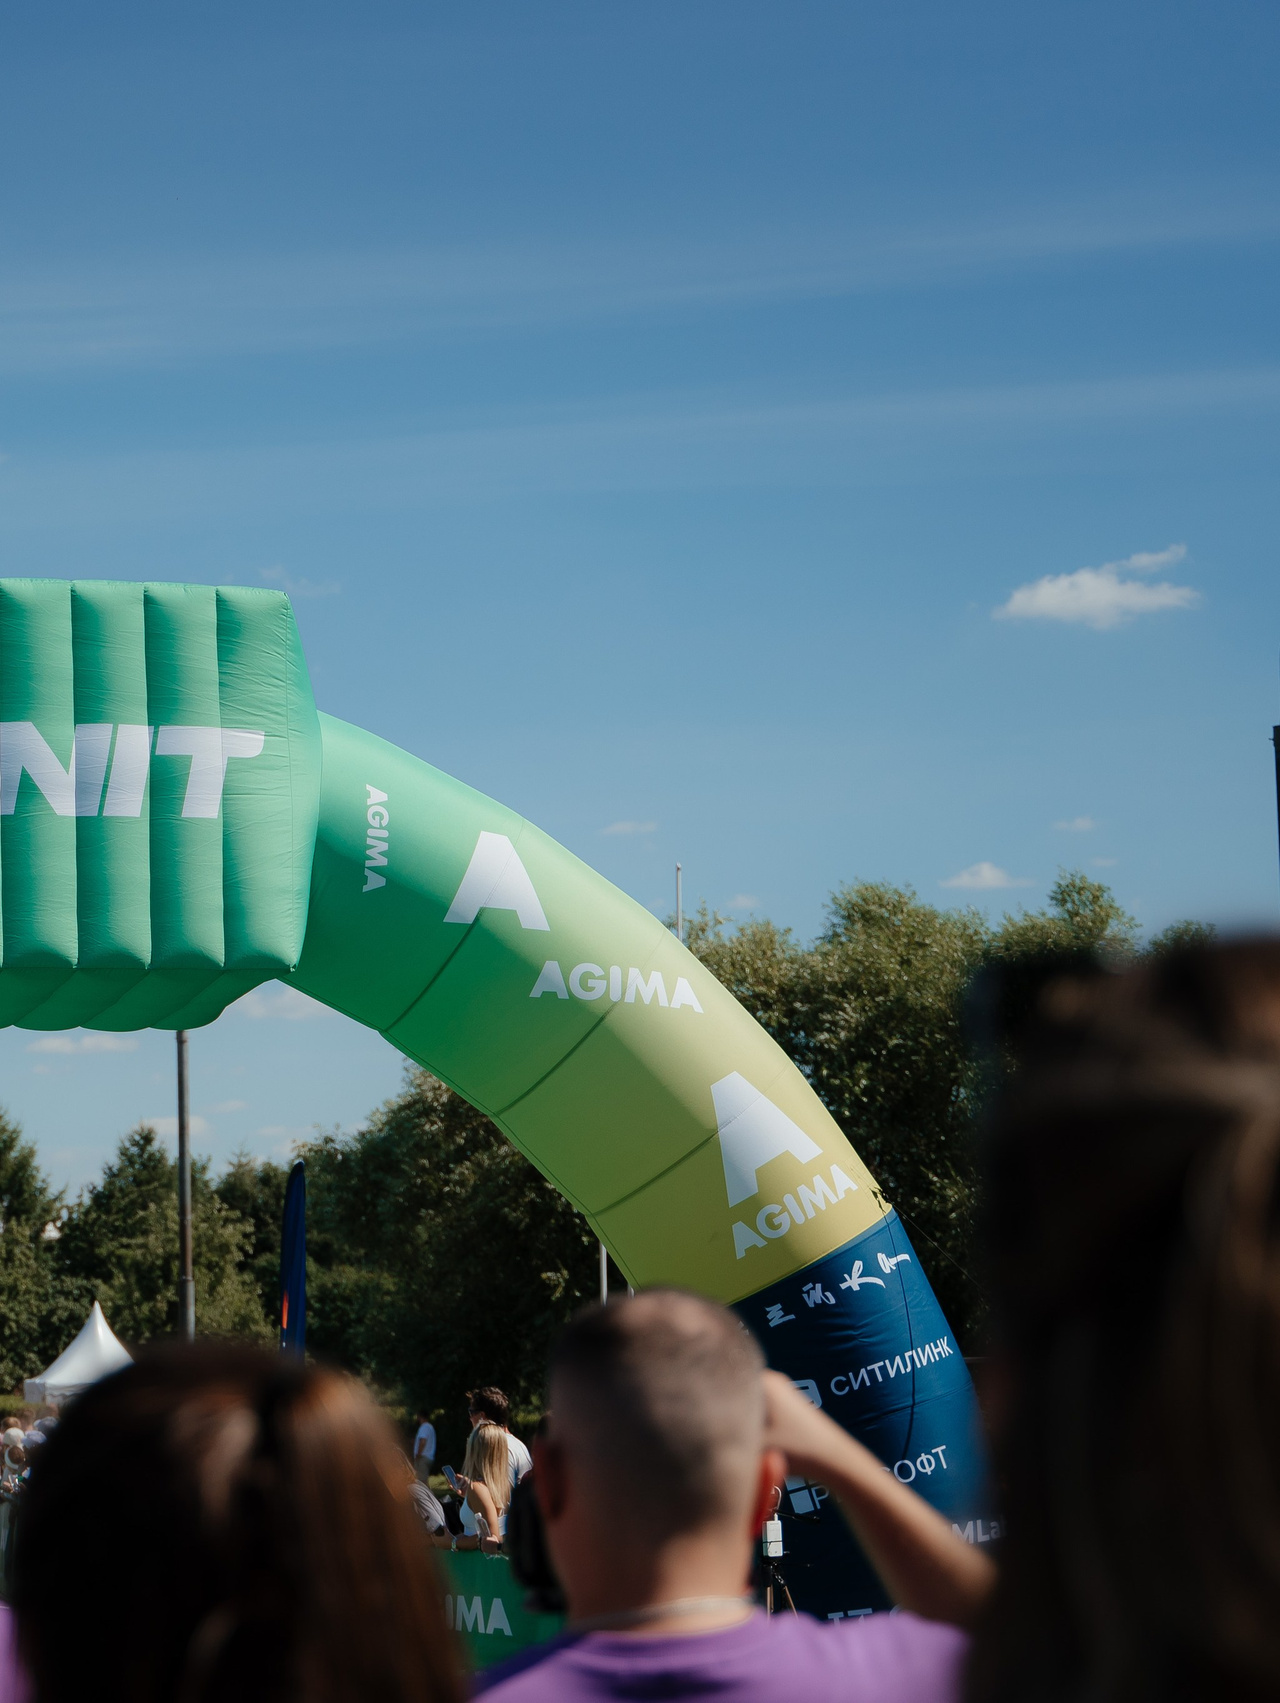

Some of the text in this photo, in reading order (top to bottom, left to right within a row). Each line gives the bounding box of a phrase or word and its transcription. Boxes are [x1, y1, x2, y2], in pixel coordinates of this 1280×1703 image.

[362, 783, 389, 893] AGIMA
[529, 960, 704, 1013] AGIMA
[731, 1163, 859, 1260] AGIMA
[830, 1336, 954, 1396] СИТИЛИНК
[445, 1594, 513, 1636] IMA
